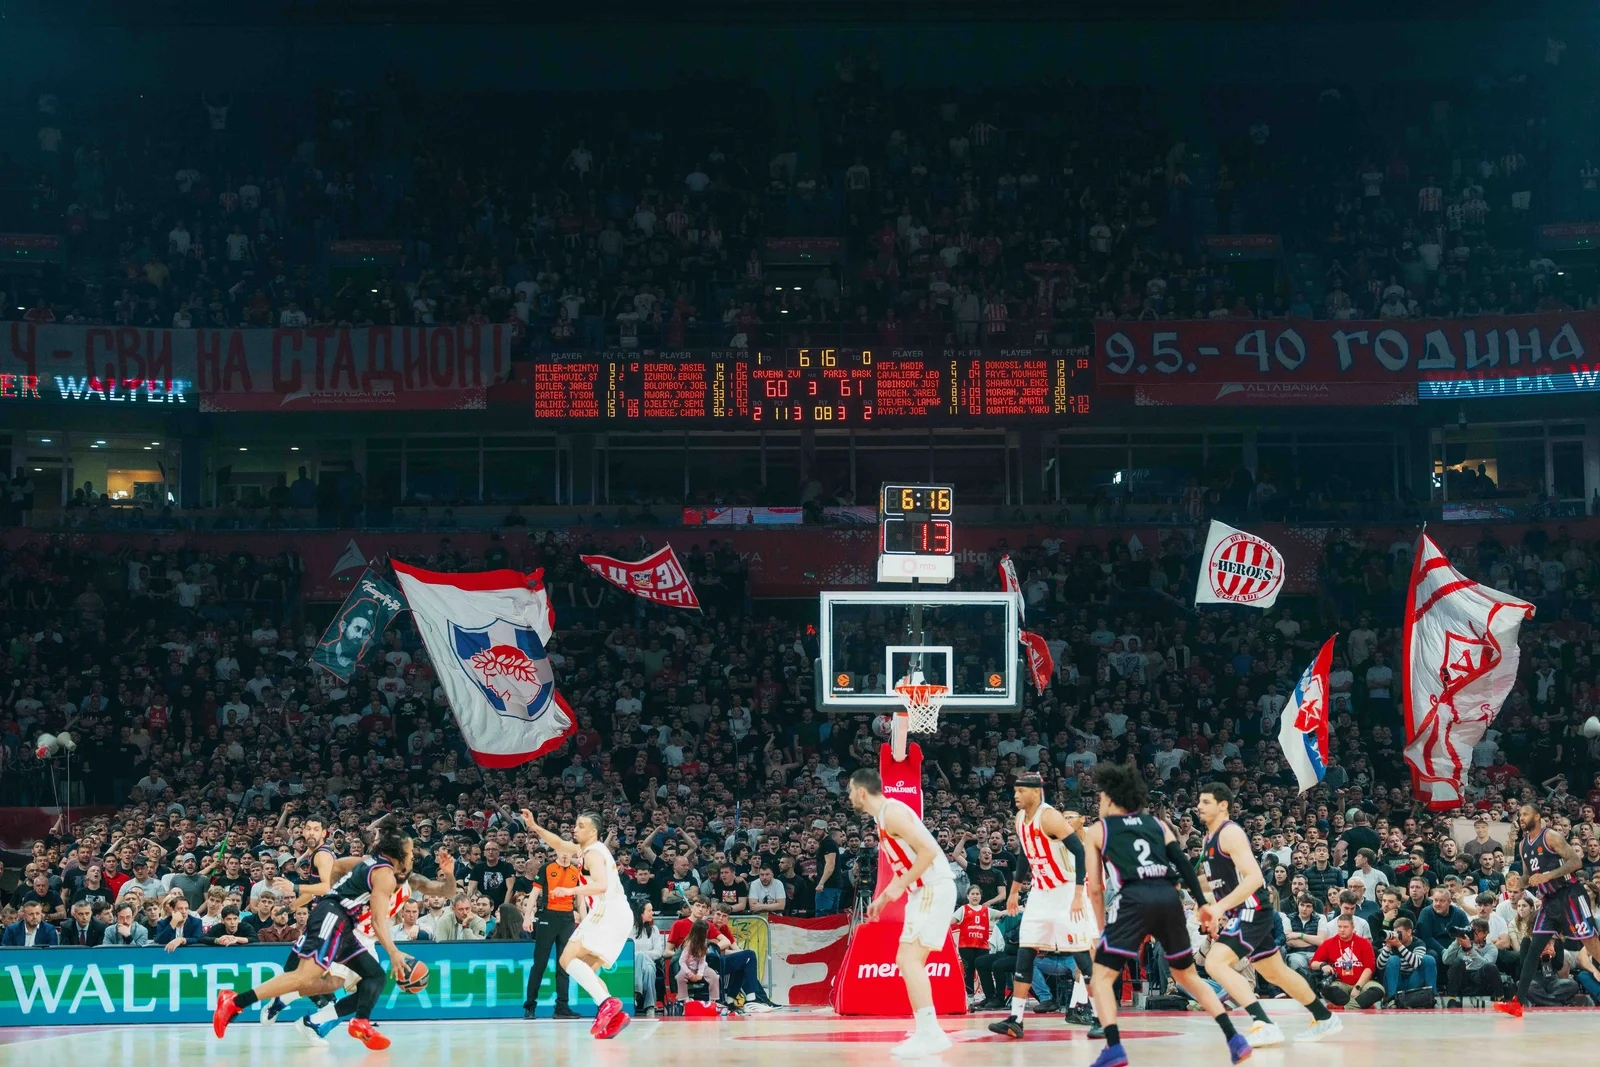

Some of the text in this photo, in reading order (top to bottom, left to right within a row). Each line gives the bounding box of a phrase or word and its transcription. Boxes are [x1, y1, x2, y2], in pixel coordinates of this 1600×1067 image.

[1235, 328, 1306, 371] 40
[86, 328, 173, 391] СВИ
[197, 328, 252, 392] НА
[272, 324, 502, 394] СТАДИОН!
[609, 363, 616, 372] 0
[716, 363, 724, 371] 14
[737, 363, 748, 371] 04
[951, 361, 957, 369] 2
[972, 361, 980, 369] 15
[1057, 360, 1065, 368] 13
[1077, 360, 1088, 368] 03
[610, 373, 616, 381] 2
[717, 372, 724, 380] 15
[737, 372, 748, 380] 06
[824, 370, 848, 378] PARIS
[951, 370, 957, 378] 4
[969, 370, 980, 378] 04
[1057, 369, 1065, 377] 15
[610, 382, 616, 390] 6
[714, 381, 724, 389] 21
[737, 381, 748, 389] 04
[951, 379, 957, 387] 5
[1058, 378, 1065, 386] 18
[767, 380, 862, 397] 60 3 61
[1055, 387, 1065, 395] 20
[1246, 383, 1328, 391] ALTABANKA
[714, 390, 724, 398] 33
[737, 390, 747, 398] 07
[952, 388, 957, 396] 8
[970, 388, 980, 396] 09
[952, 397, 958, 405] 9
[970, 397, 980, 405] 07
[1055, 396, 1065, 404] 22
[1078, 395, 1089, 404] 07
[608, 400, 616, 408] 12
[628, 400, 639, 408] 02
[608, 409, 616, 417] 13
[628, 409, 639, 417] 09
[714, 409, 724, 417] 95
[970, 406, 980, 414] 03
[1055, 405, 1066, 413] 24
[1078, 405, 1090, 413] 02
[754, 407, 762, 420] 2
[794, 407, 801, 420] 3
[815, 407, 832, 420] 08
[838, 407, 845, 419] 3
[864, 407, 872, 420] 2
[902, 489, 950, 511] 6:16
[1218, 559, 1273, 581] HEROES
[884, 786, 917, 796] SPALDING
[1133, 839, 1154, 866] 2
[1530, 857, 1540, 871] 22
[1137, 864, 1168, 880] PARIS
[1575, 921, 1590, 935] 22
[858, 962, 951, 979] meran
